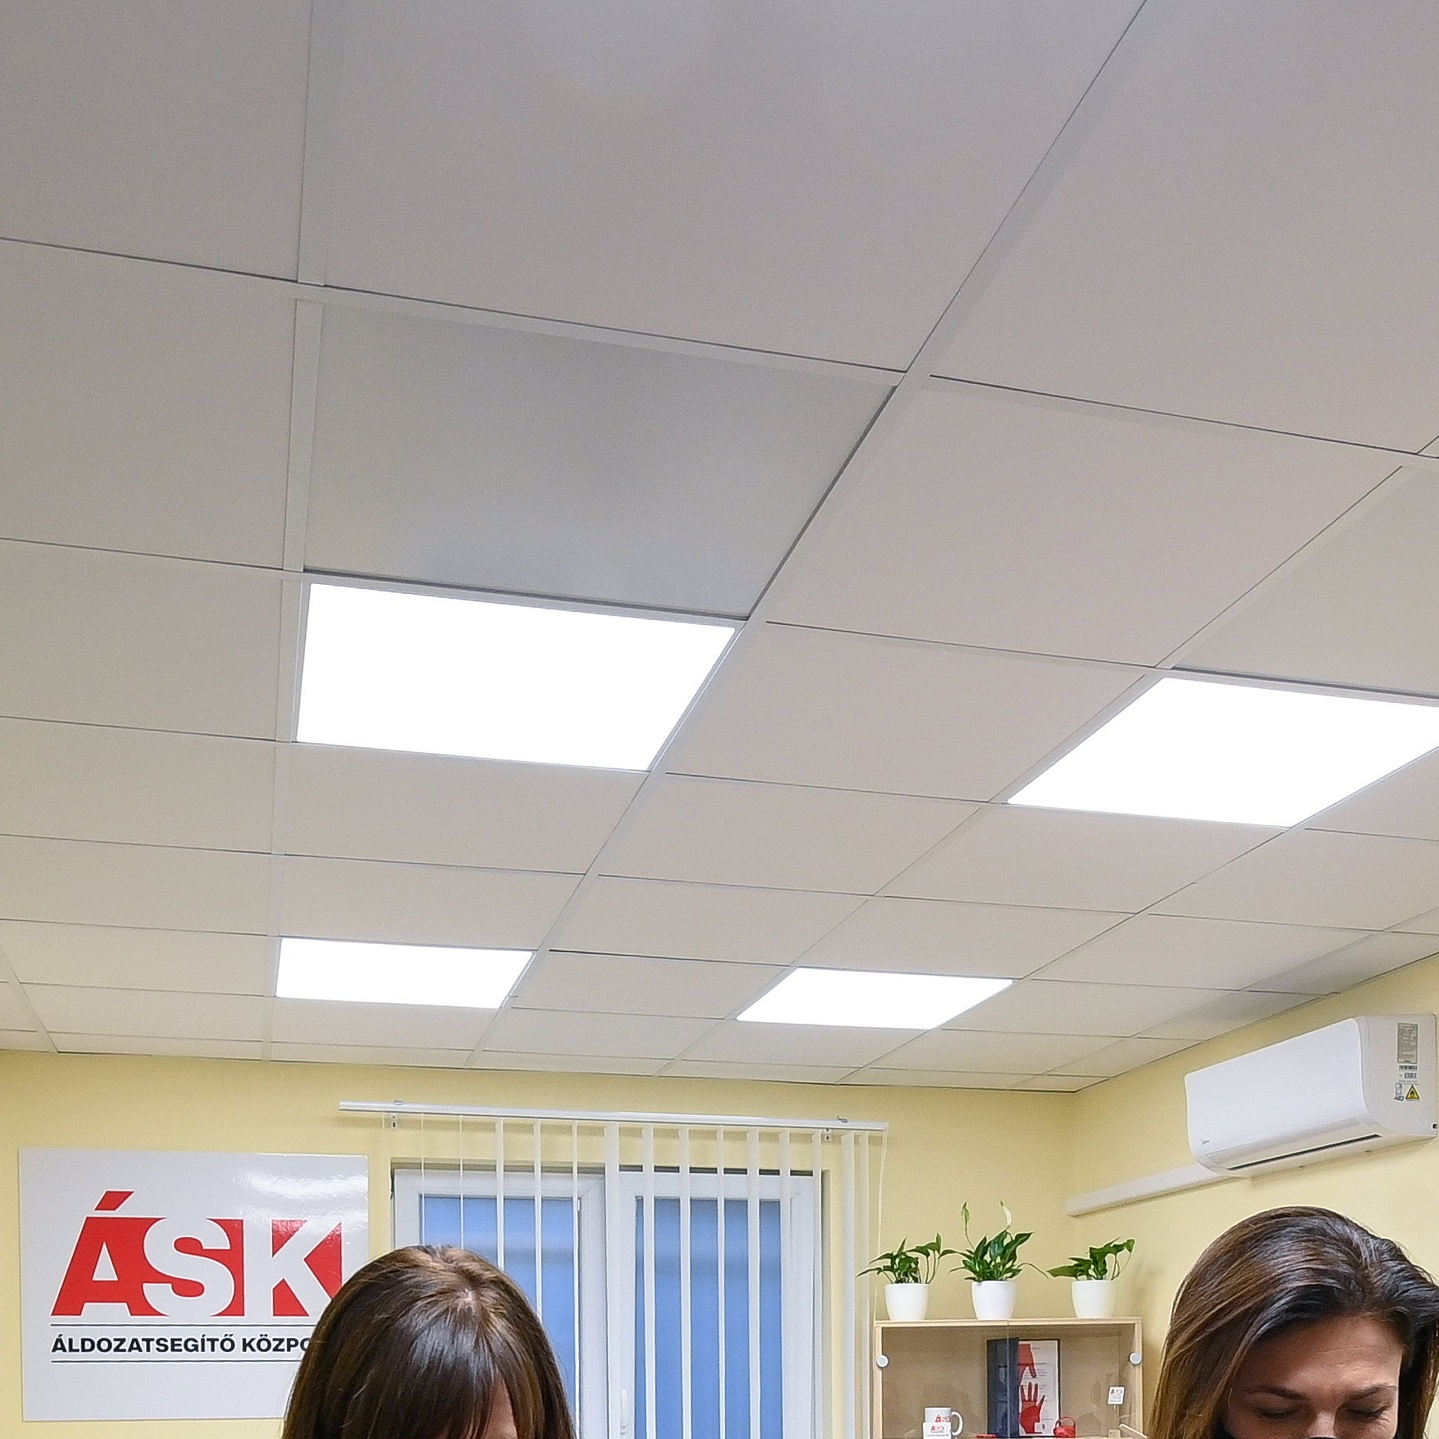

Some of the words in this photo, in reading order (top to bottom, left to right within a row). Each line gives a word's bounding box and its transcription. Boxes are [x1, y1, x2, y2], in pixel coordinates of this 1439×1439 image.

[50, 1190, 344, 1317] ÁSK
[51, 1333, 236, 1354] ÁLDOZATSEGÍTŐ
[242, 1334, 311, 1353] KÖZPO
